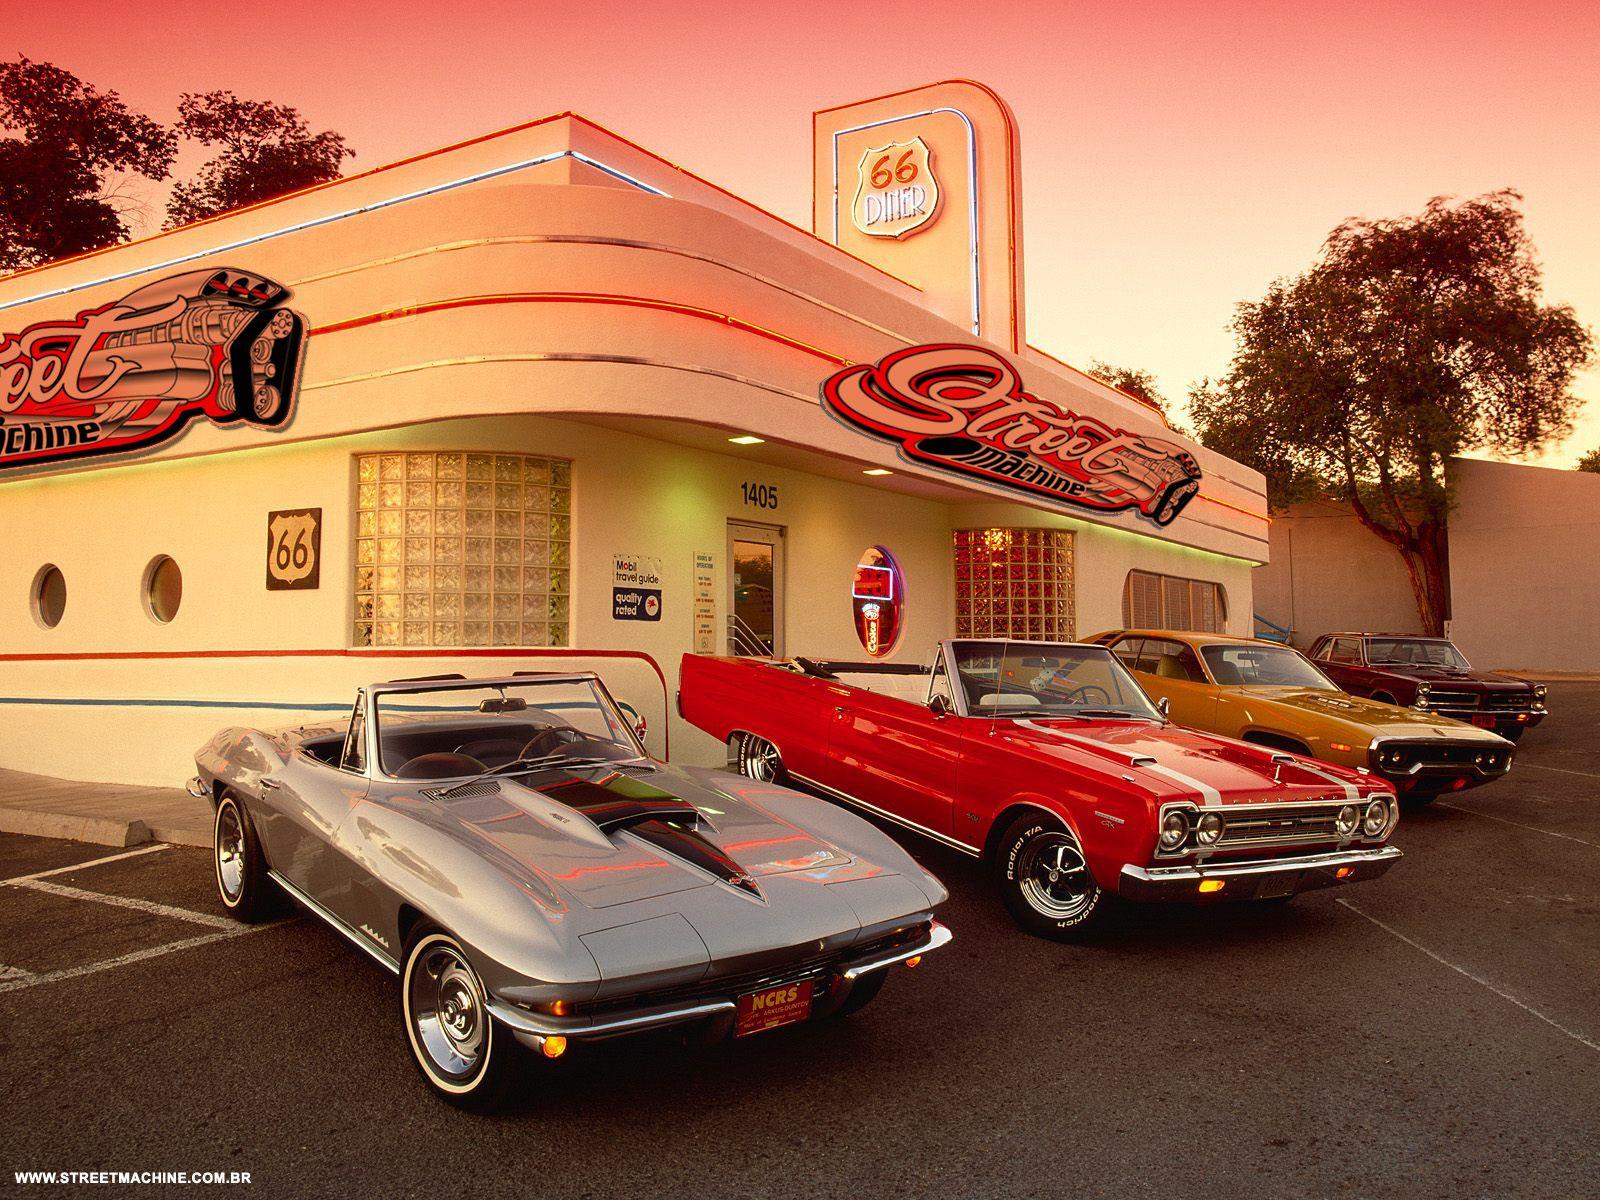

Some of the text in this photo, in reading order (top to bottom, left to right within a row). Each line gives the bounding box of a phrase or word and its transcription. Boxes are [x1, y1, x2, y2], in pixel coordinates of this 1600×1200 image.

[870, 149, 918, 189] 66
[864, 186, 926, 226] DINER
[836, 347, 1170, 474] Street
[741, 482, 778, 509] 1405
[276, 527, 308, 570] 66
[616, 560, 637, 571] Mobil
[616, 571, 659, 585] travel guide
[615, 592, 643, 606] quality
[615, 605, 637, 616] rated
[752, 986, 798, 1012] NCRS
